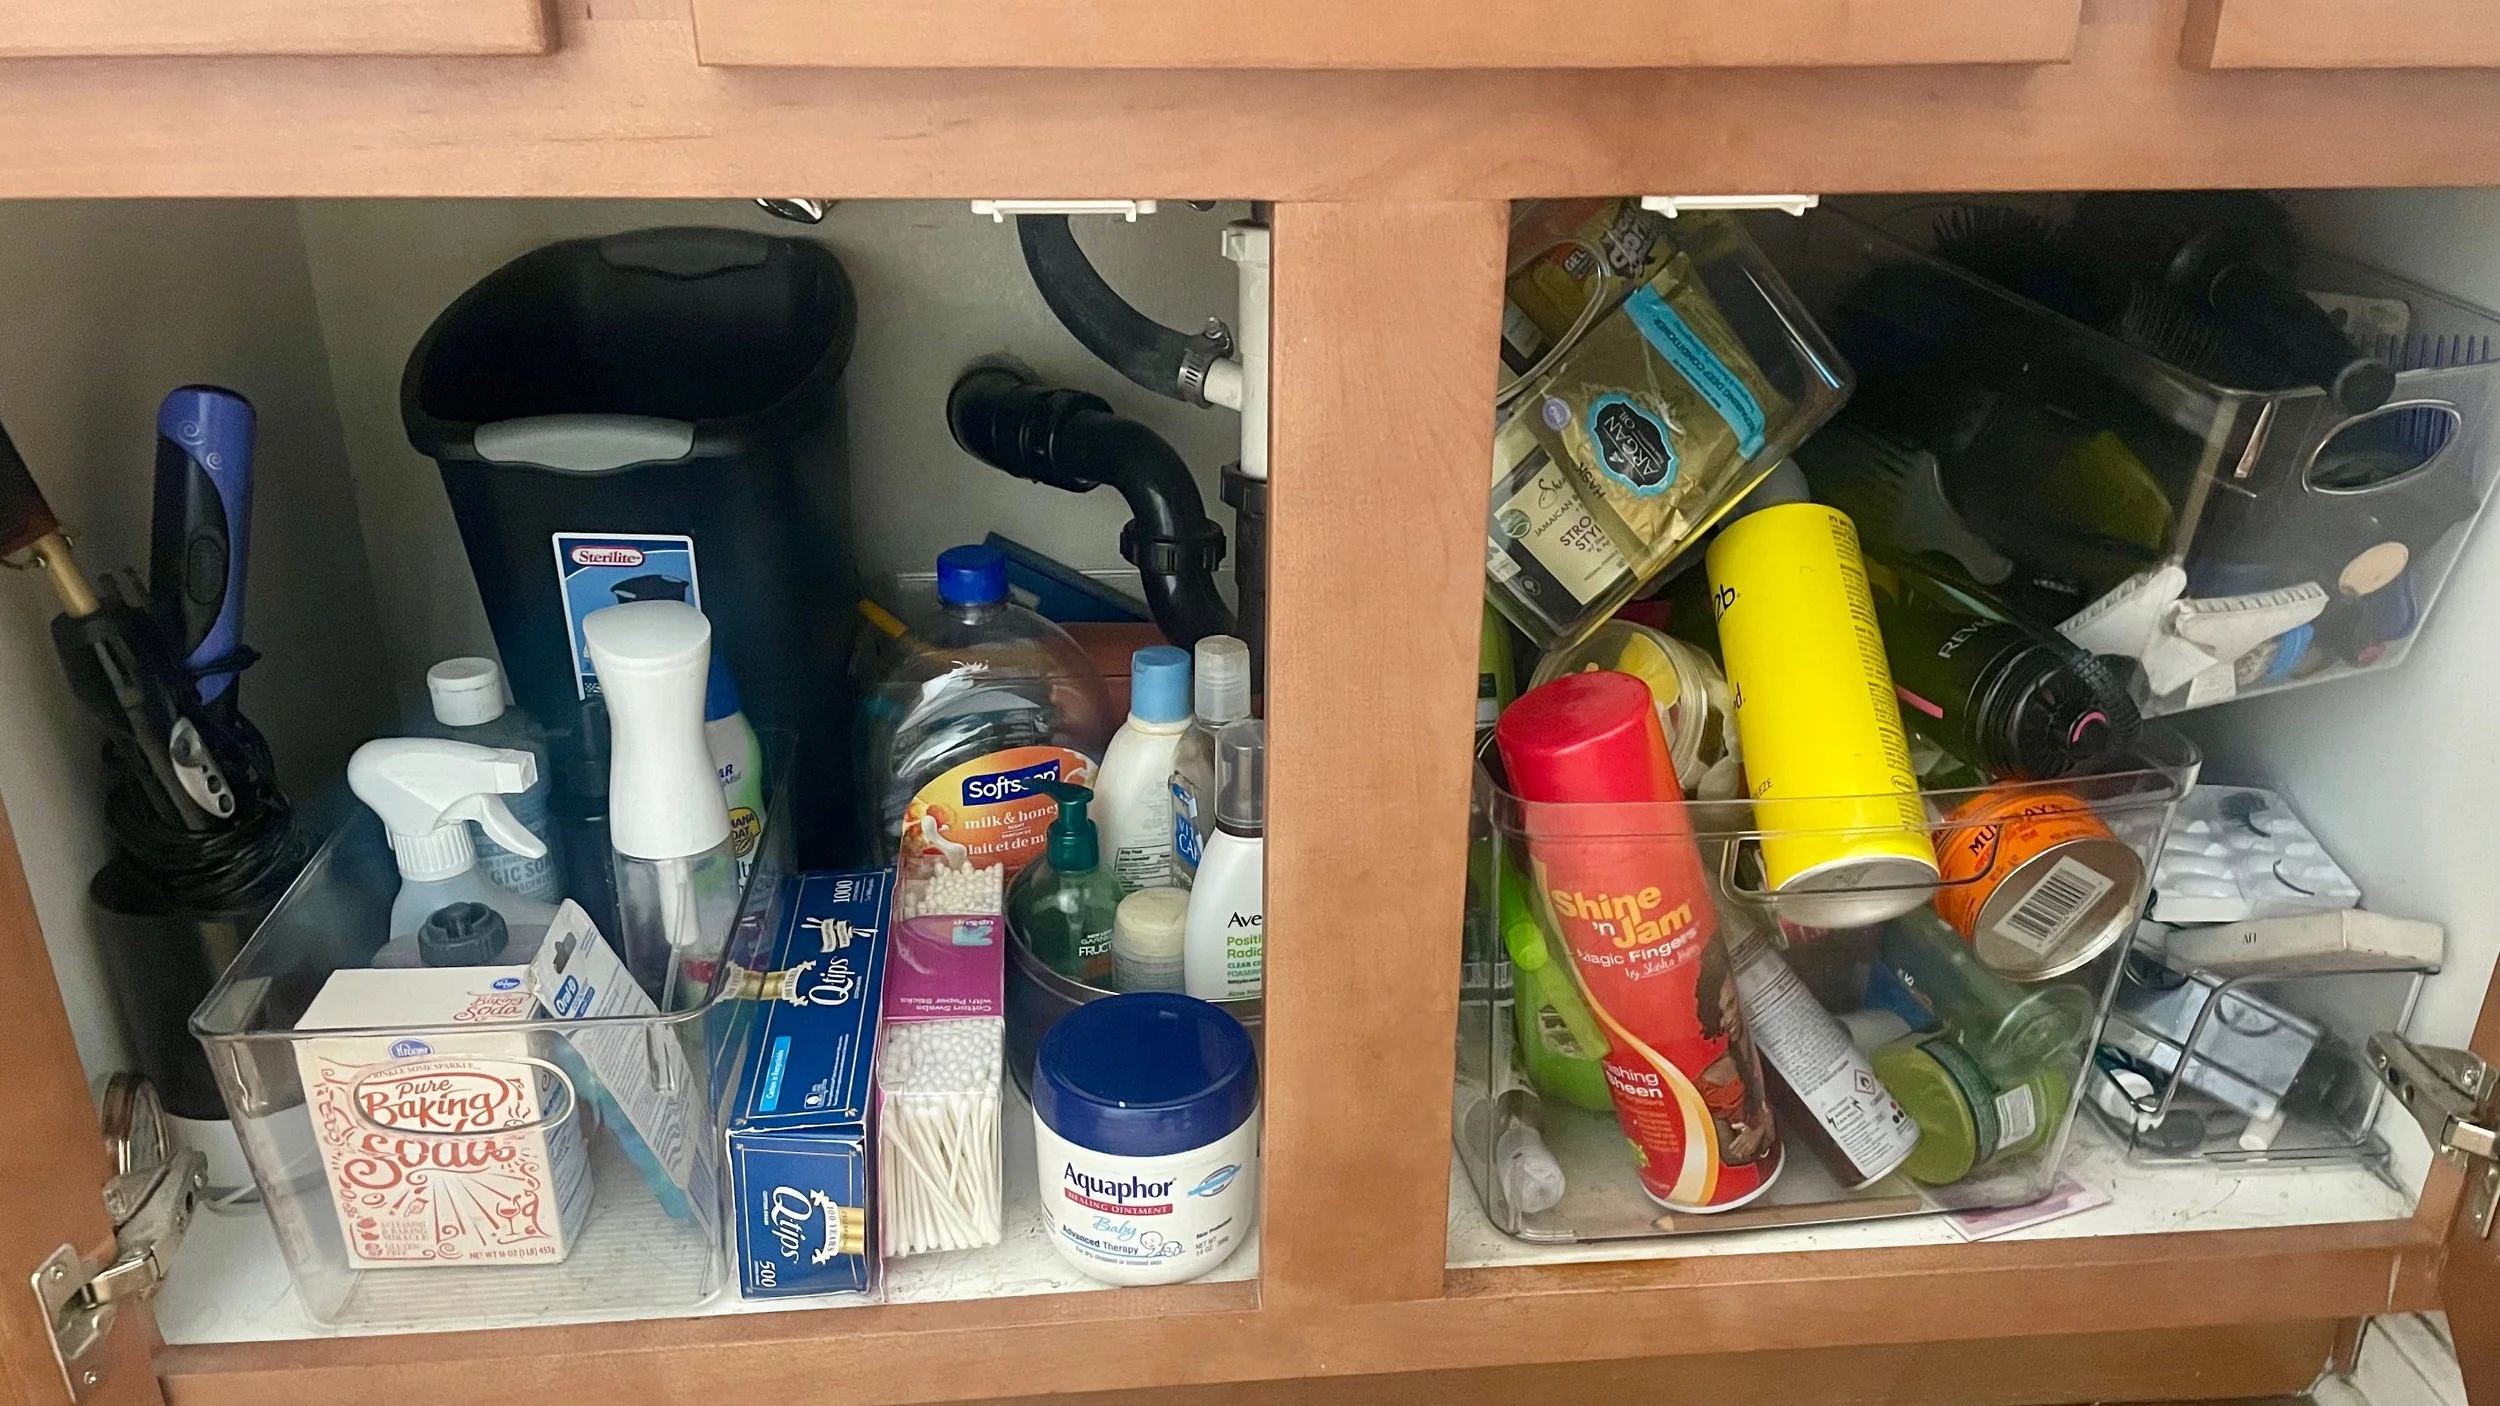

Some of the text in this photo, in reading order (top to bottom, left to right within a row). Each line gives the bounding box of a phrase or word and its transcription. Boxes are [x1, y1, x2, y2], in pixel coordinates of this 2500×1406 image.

[1653, 318, 1706, 368] CONDITIONER
[1618, 409, 1636, 430] OIL
[1605, 414, 1661, 477] ARGAN
[1576, 460, 1606, 500] HASK
[1534, 499, 1573, 537] JAMAICAN
[1559, 516, 1591, 548] STRO
[579, 550, 637, 564] Sterilite
[968, 770, 1056, 800] Softs
[964, 815, 1002, 830] milk
[1003, 811, 1016, 825] &
[968, 844, 994, 855] lait
[995, 841, 1010, 853] et
[1011, 837, 1029, 850] de
[490, 866, 523, 886] GIC
[833, 880, 853, 903] 1000
[1550, 886, 1662, 925] Shine
[1227, 912, 1262, 928] Ave
[1613, 902, 1693, 949] Jam
[1078, 941, 1112, 957] FRUCT
[1226, 934, 1262, 946] Positi
[1628, 927, 1697, 963] Fingers
[808, 956, 853, 1007] Q-tips
[453, 1003, 523, 1022] Soda
[916, 1005, 953, 1013] Swabs
[366, 1066, 405, 1080] RINKLE
[407, 1063, 431, 1075] SOME
[396, 1077, 453, 1100] Pure
[360, 1090, 500, 1128] Baking
[343, 1120, 516, 1190] Soda
[1063, 1161, 1174, 1204] Aquaphor
[1068, 1191, 1168, 1214] HEALING OINTMENT
[770, 1185, 813, 1262] Q-tips
[826, 1205, 838, 1252] 100 YEARS
[1091, 1215, 1137, 1242] Baby
[1062, 1224, 1139, 1255] Advanced Therapy
[469, 1252, 483, 1260] NET
[485, 1251, 497, 1259] WT
[758, 1260, 777, 1288] 500
